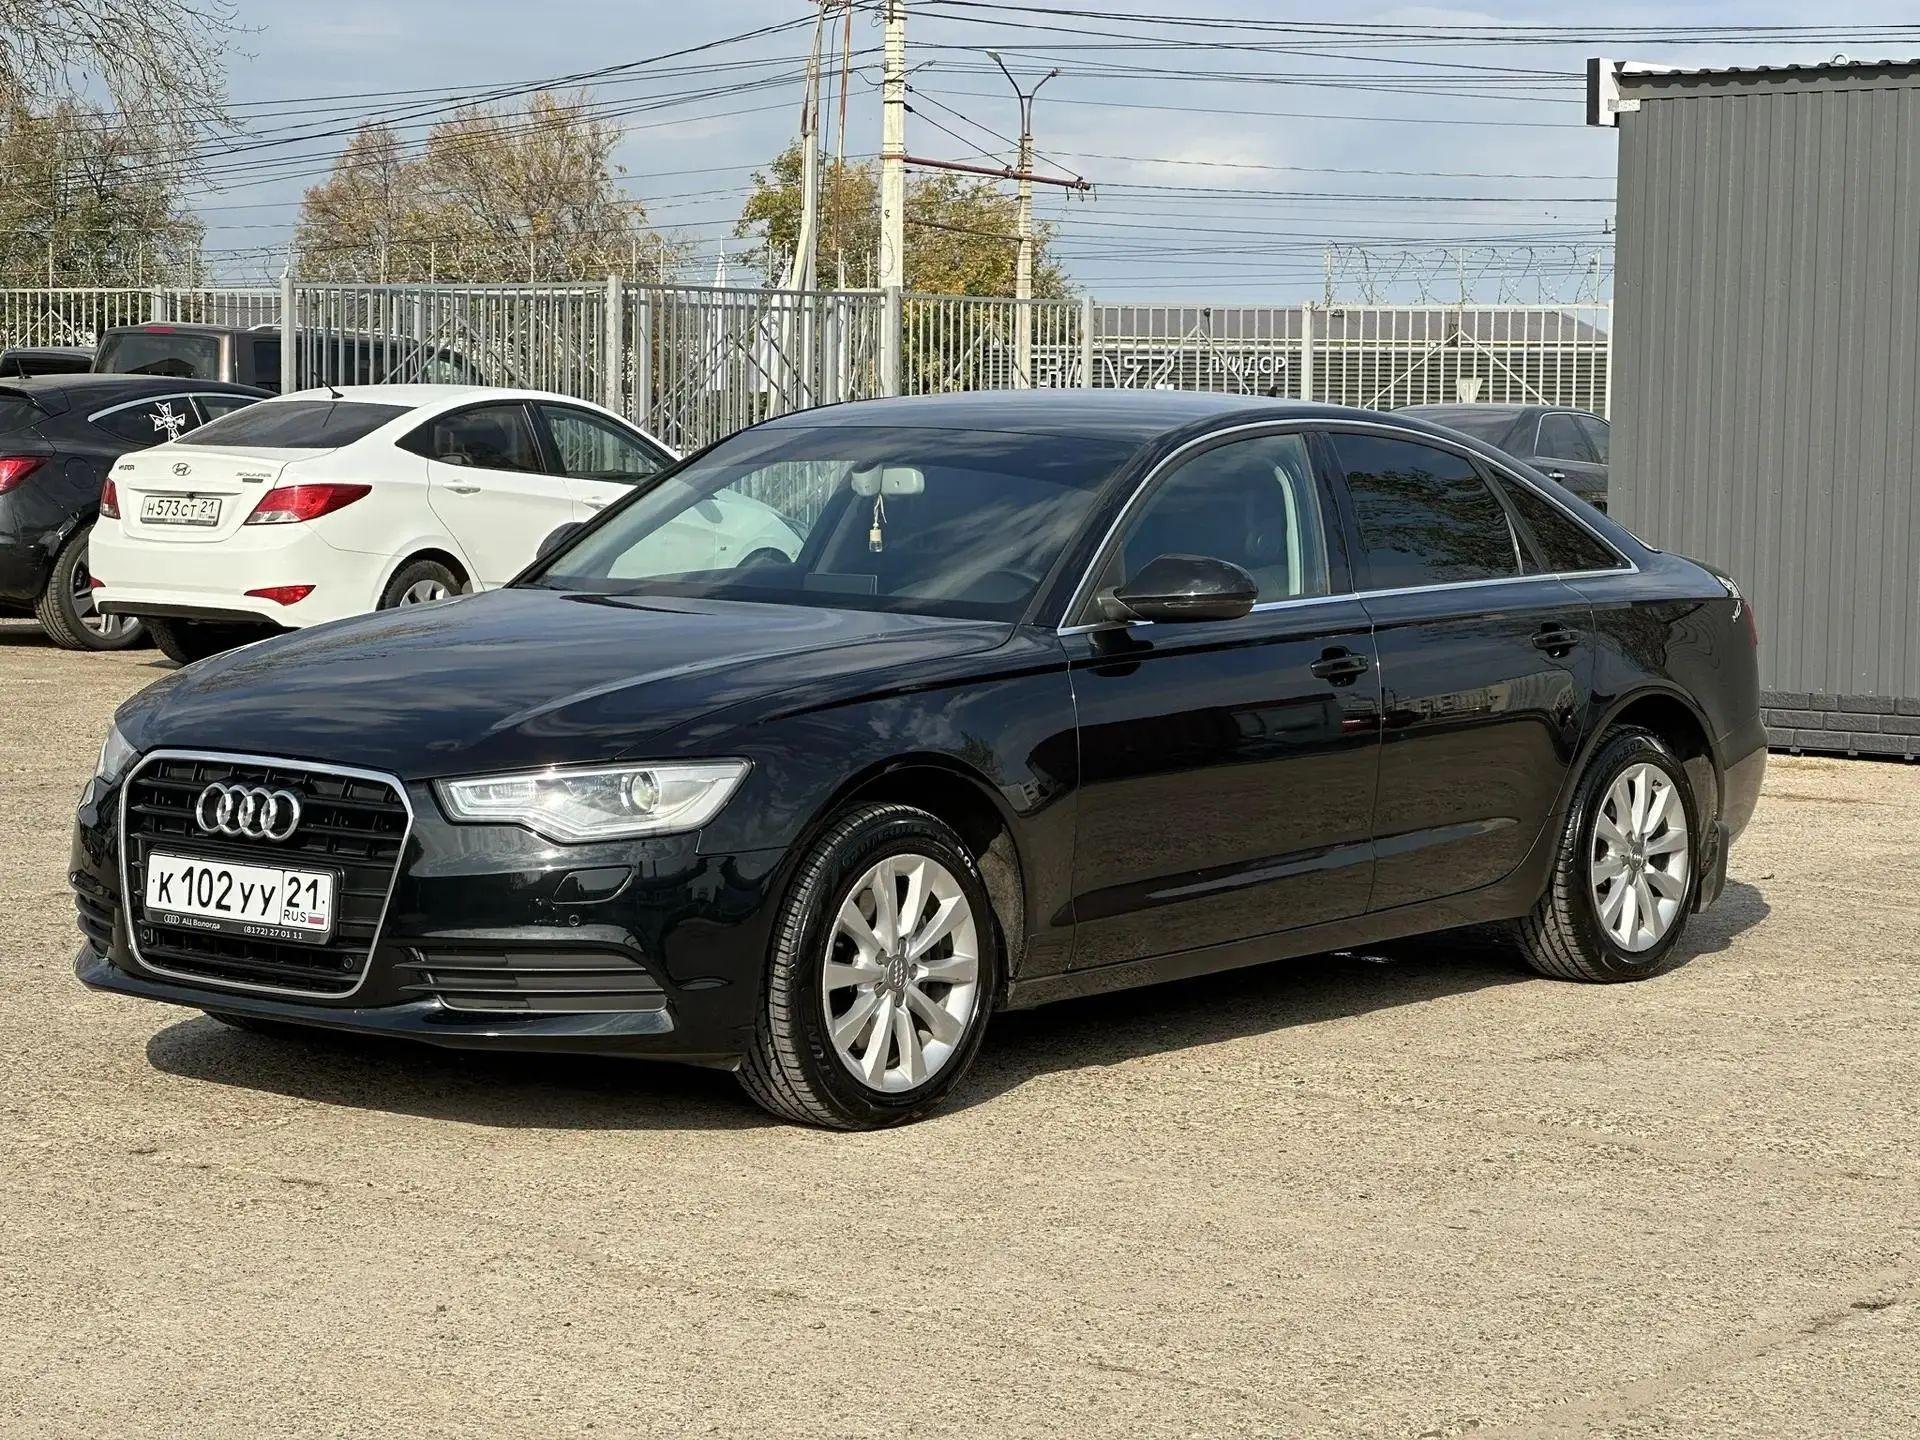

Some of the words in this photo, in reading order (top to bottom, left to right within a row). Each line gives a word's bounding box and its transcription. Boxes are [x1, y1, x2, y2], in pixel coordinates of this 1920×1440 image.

[146, 499, 197, 517] Н573СТ
[200, 500, 215, 514] 21
[158, 866, 276, 916] К102УУ
[286, 876, 318, 910] 21
[283, 909, 307, 923] RUS
[181, 917, 193, 927] АЦ
[192, 919, 221, 930] Вологда
[243, 925, 268, 936] (8172)
[269, 928, 280, 938] 27
[280, 930, 292, 939] 01
[292, 932, 303, 940] 11
